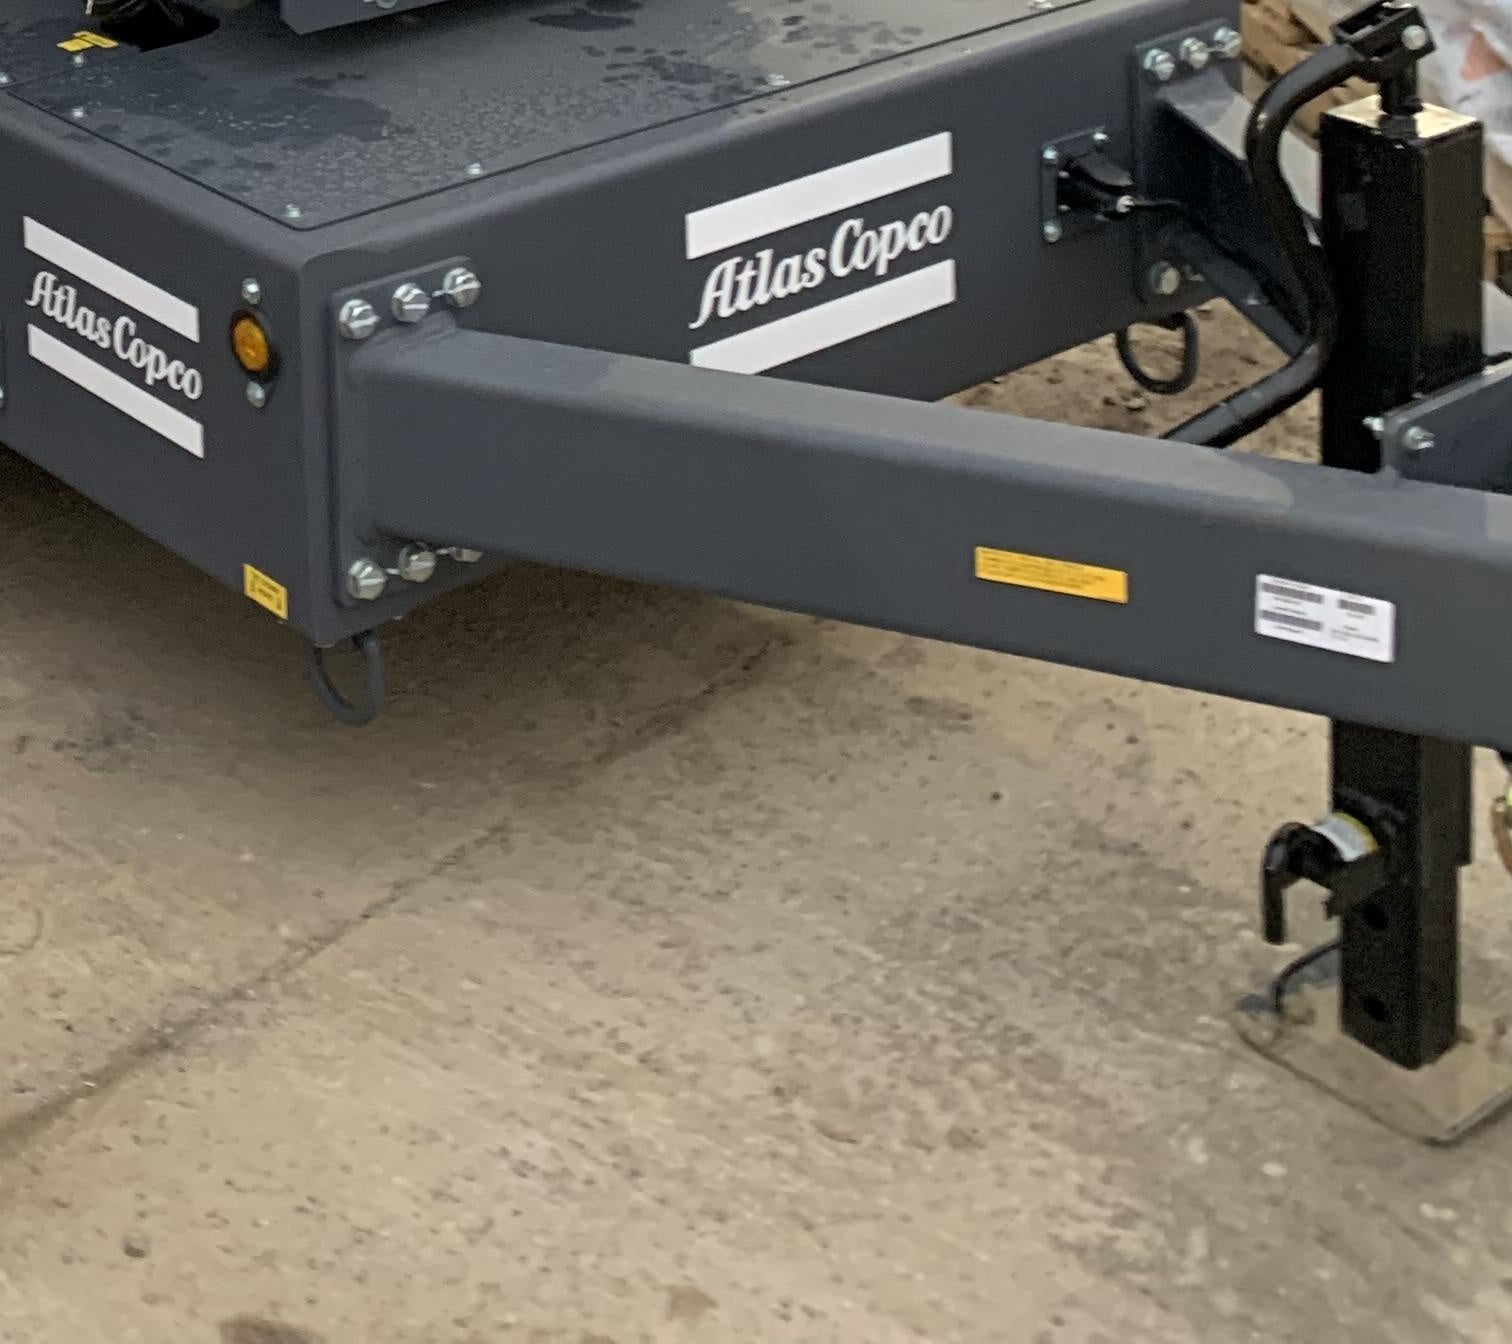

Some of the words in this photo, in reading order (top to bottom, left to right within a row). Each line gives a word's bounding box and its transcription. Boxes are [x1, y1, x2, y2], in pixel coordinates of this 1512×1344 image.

[689, 248, 826, 329] Atlas
[829, 205, 952, 276] Copco
[25, 271, 112, 349] Atlas
[113, 316, 202, 400] Copco
